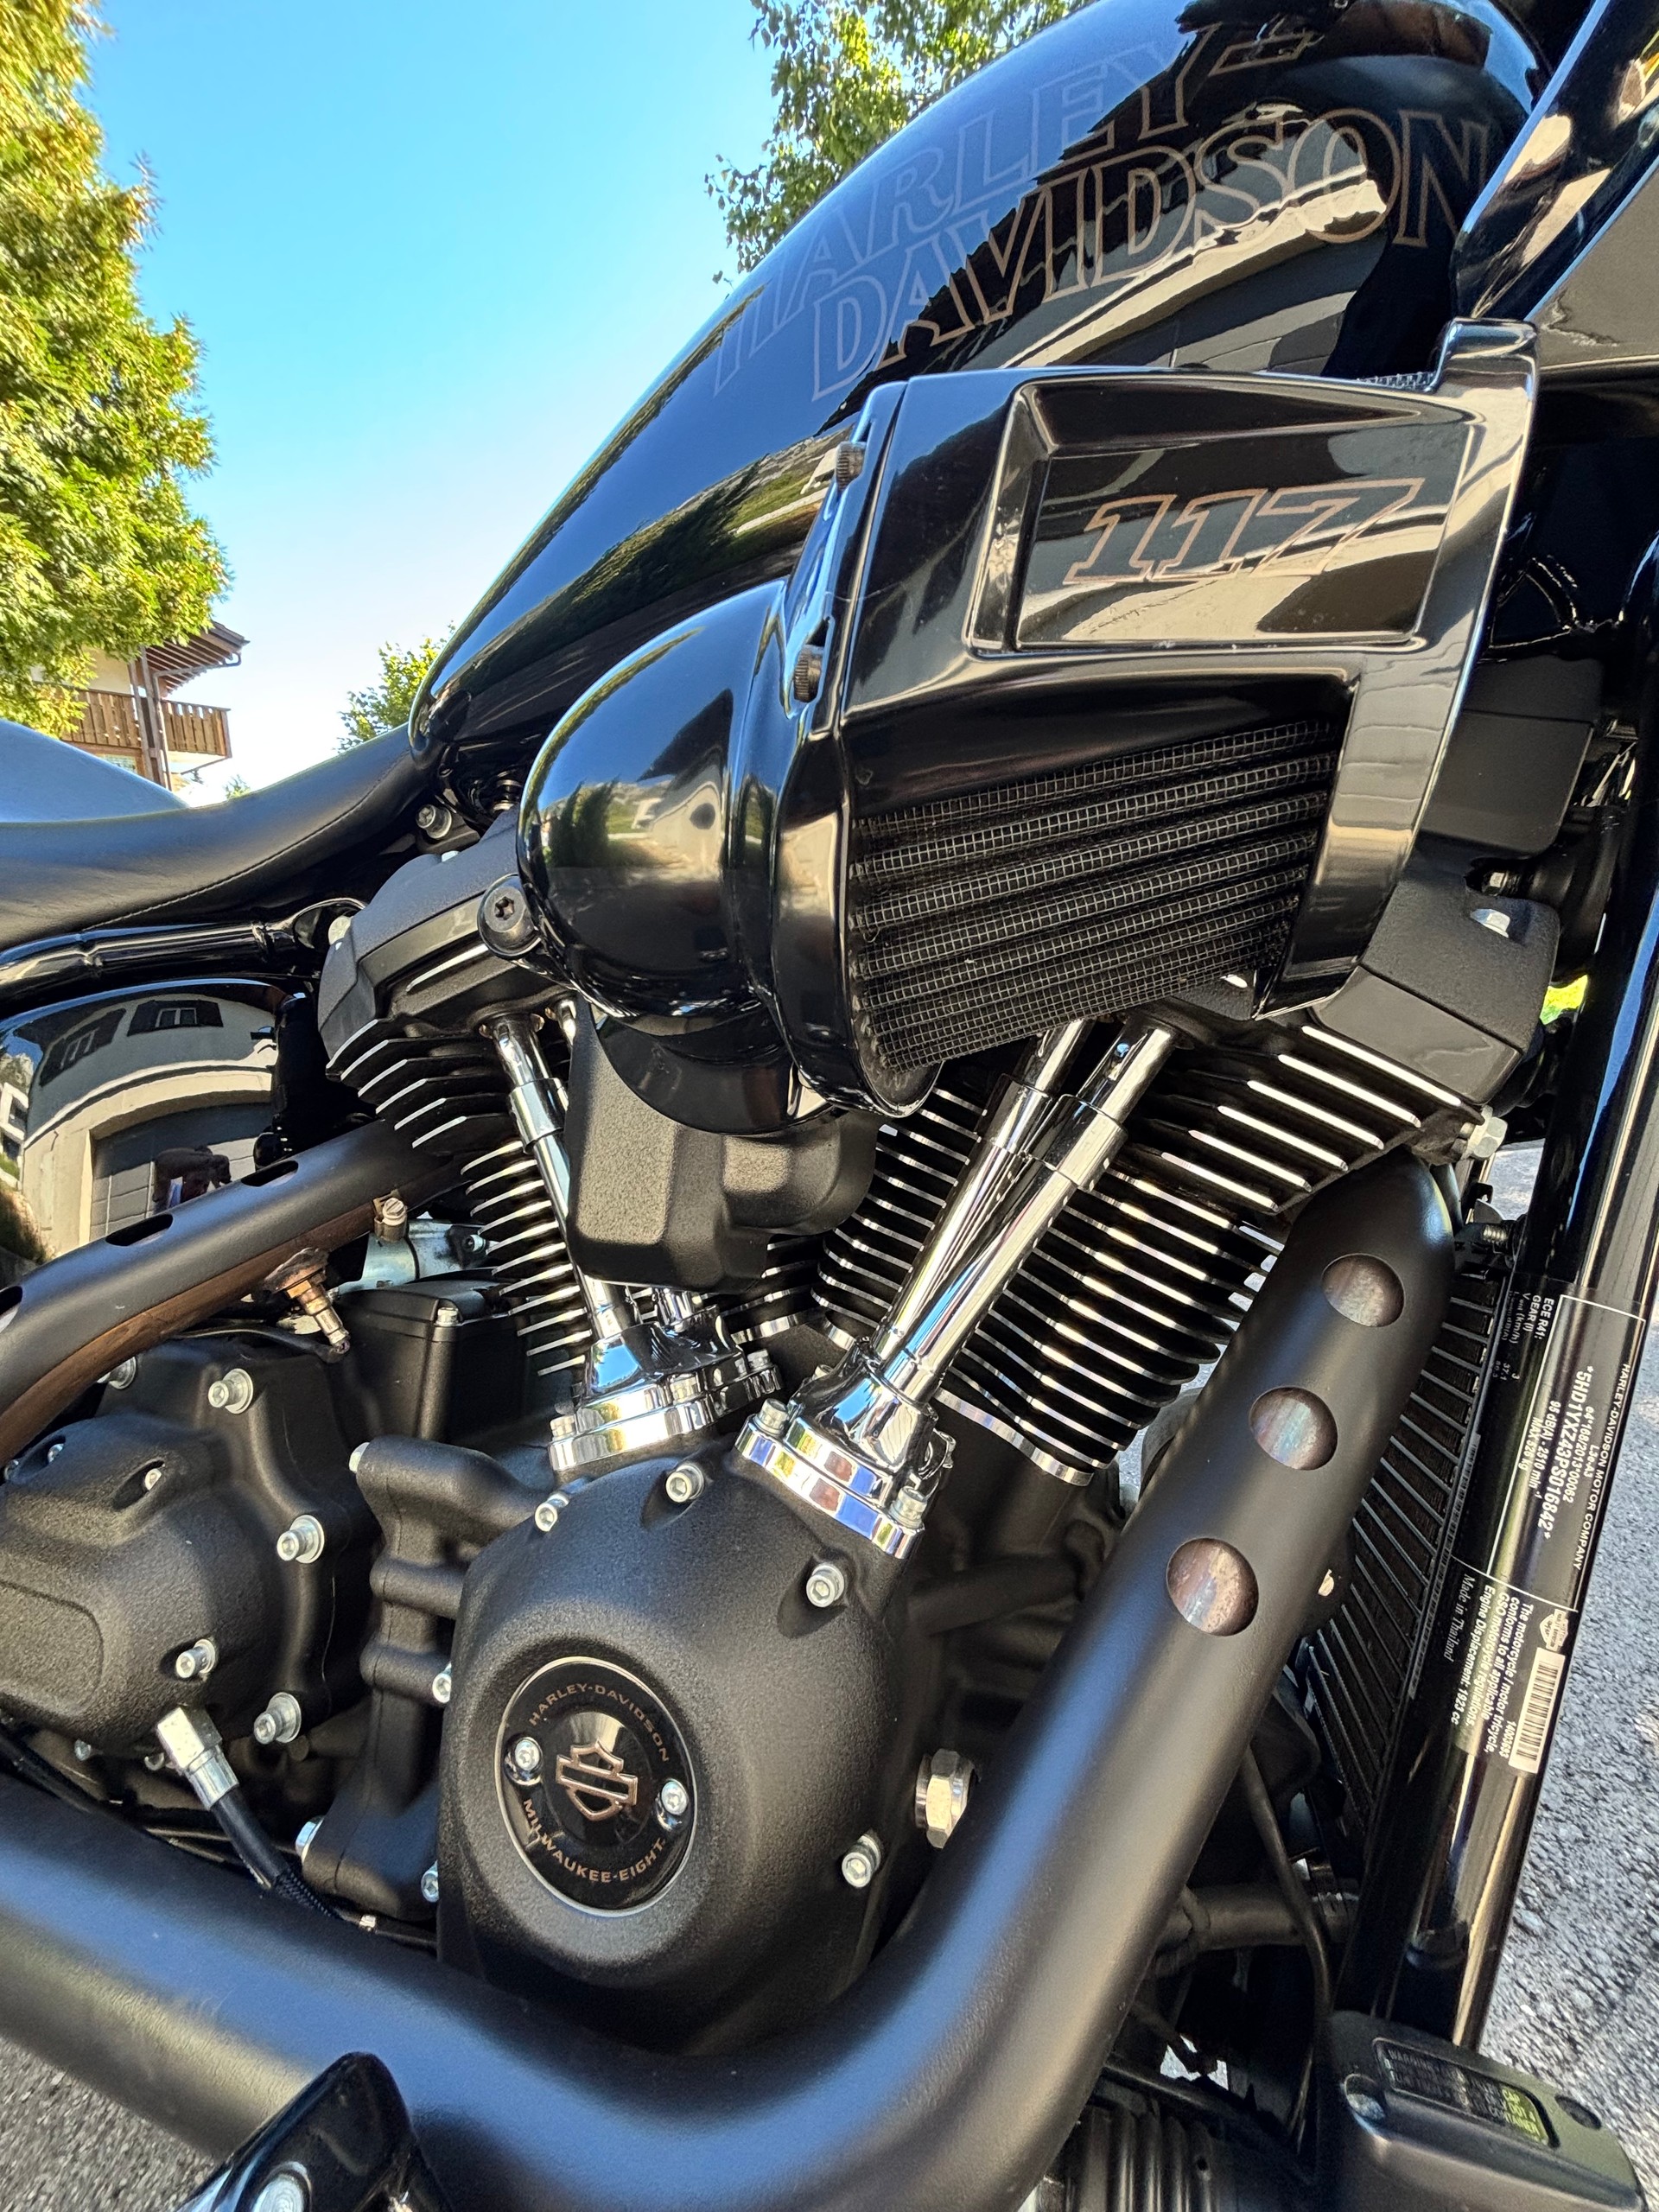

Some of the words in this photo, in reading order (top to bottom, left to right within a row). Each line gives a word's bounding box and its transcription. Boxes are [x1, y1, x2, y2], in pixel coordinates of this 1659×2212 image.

[810, 107, 1490, 401] DAVIDSON
[1062, 477, 1425, 584] 117
[1527, 1294, 1541, 1322] GEAR
[1540, 1298, 1554, 1318] ECE
[1509, 1313, 1525, 1344] (km/h)
[1534, 1319, 1548, 1339] R41:
[1548, 1400, 1561, 1414] 95
[1598, 1363, 1630, 1466] HARLEY-DAVIDSON
[1528, 1416, 1543, 1441] MAX
[1538, 1411, 1557, 1440] dB(A)
[1516, 1458, 1532, 1471] kg
[1532, 1446, 1549, 1470] 2510
[1586, 1469, 1604, 1510] MOTOR
[1573, 1513, 1593, 1570] COMPANY
[1459, 1573, 1475, 1602] Made
[1478, 1585, 1496, 1621] Engine
[1455, 1603, 1468, 1615] in
[1495, 1592, 1510, 1616] GSO
[1519, 1603, 1534, 1621] The
[1500, 1597, 1520, 1643] conforms
[1443, 1617, 1465, 1662] Thailand
[1460, 1618, 1487, 1687] Displacement:
[1480, 1615, 1502, 1670] motorcycle
[1497, 1643, 1510, 1657] to
[1503, 1619, 1526, 1677] motorcycle
[1492, 1656, 1505, 1671] all
[1454, 1688, 1468, 1712] 1923
[1465, 1669, 1490, 1730] regulations.
[1478, 1666, 1501, 1719] applicable
[1495, 1682, 1510, 1714] motor
[529, 1682, 671, 1763] HARLEY-DAVIDSON
[1451, 1711, 1460, 1725] cc
[1484, 1713, 1504, 1752] tricycle,
[523, 1797, 666, 1884] MILWAUKEE-EIGHT
